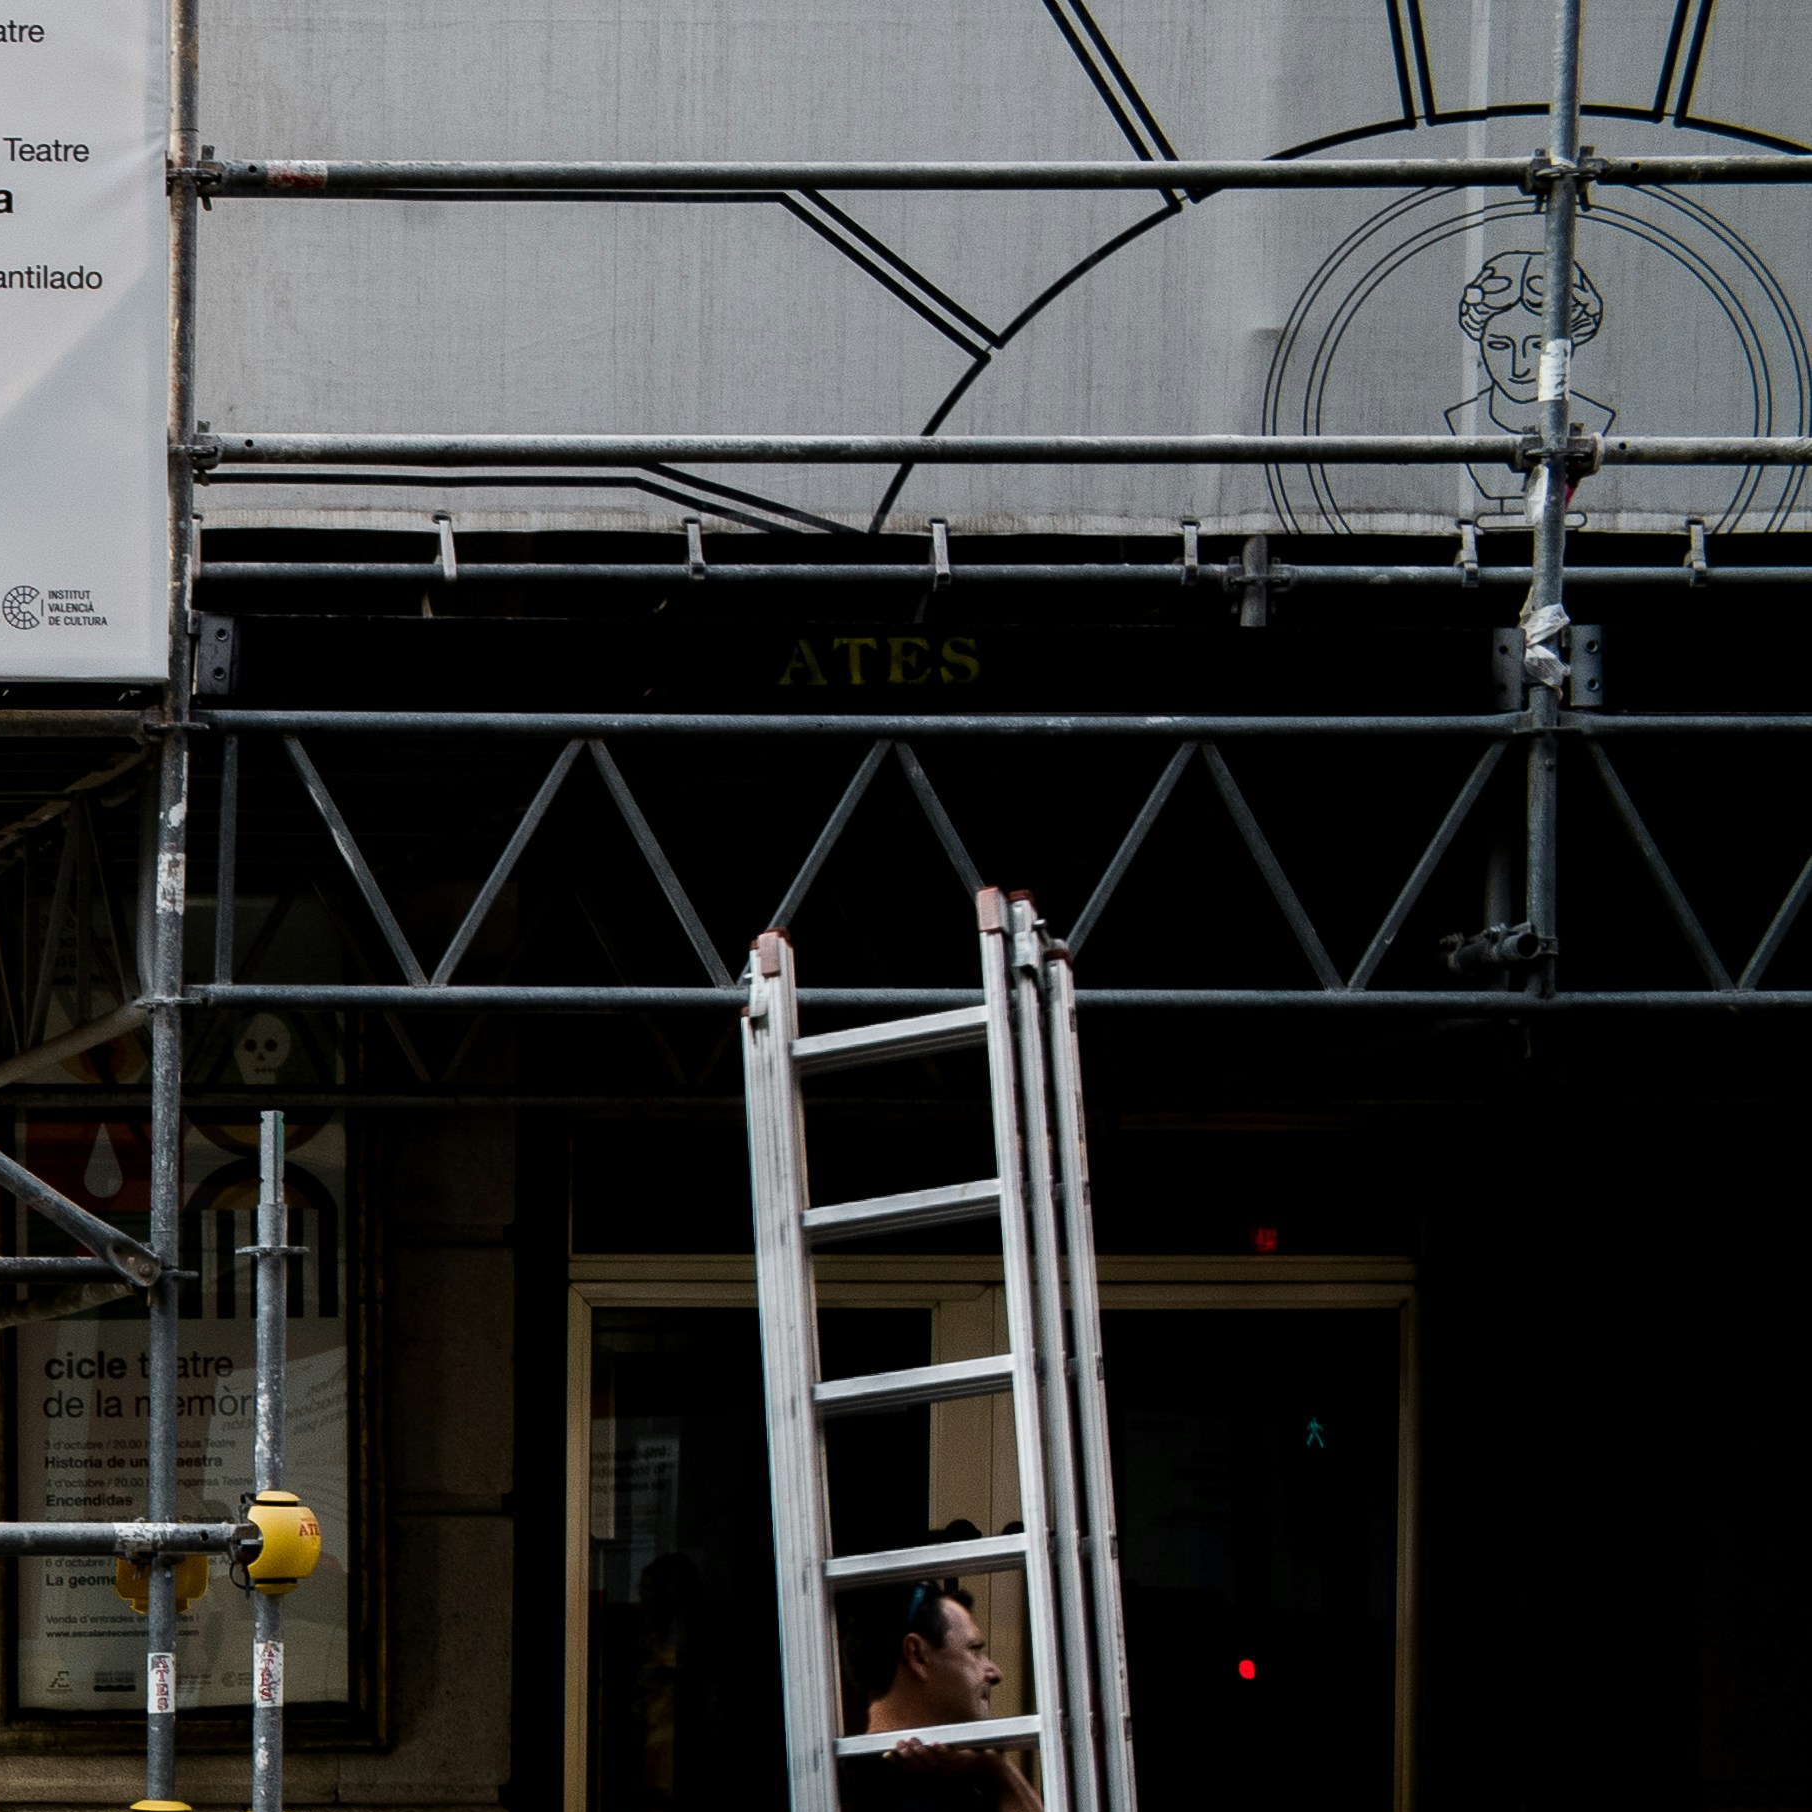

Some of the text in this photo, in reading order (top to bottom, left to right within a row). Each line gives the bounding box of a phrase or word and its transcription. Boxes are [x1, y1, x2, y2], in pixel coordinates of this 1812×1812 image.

[1, 136, 91, 163] Teatre
[48, 590, 91, 599] INSTITUT
[48, 601, 94, 613] VALENCIÀ
[48, 616, 107, 626] DE CULTURA
[777, 637, 981, 687] ATES
[44, 1351, 233, 1380] cicle tatre
[43, 1390, 123, 1418] de la
[45, 1456, 223, 1469] Historia de un aestra
[46, 1495, 132, 1506] Encendidas
[46, 1574, 116, 1589] La geome
